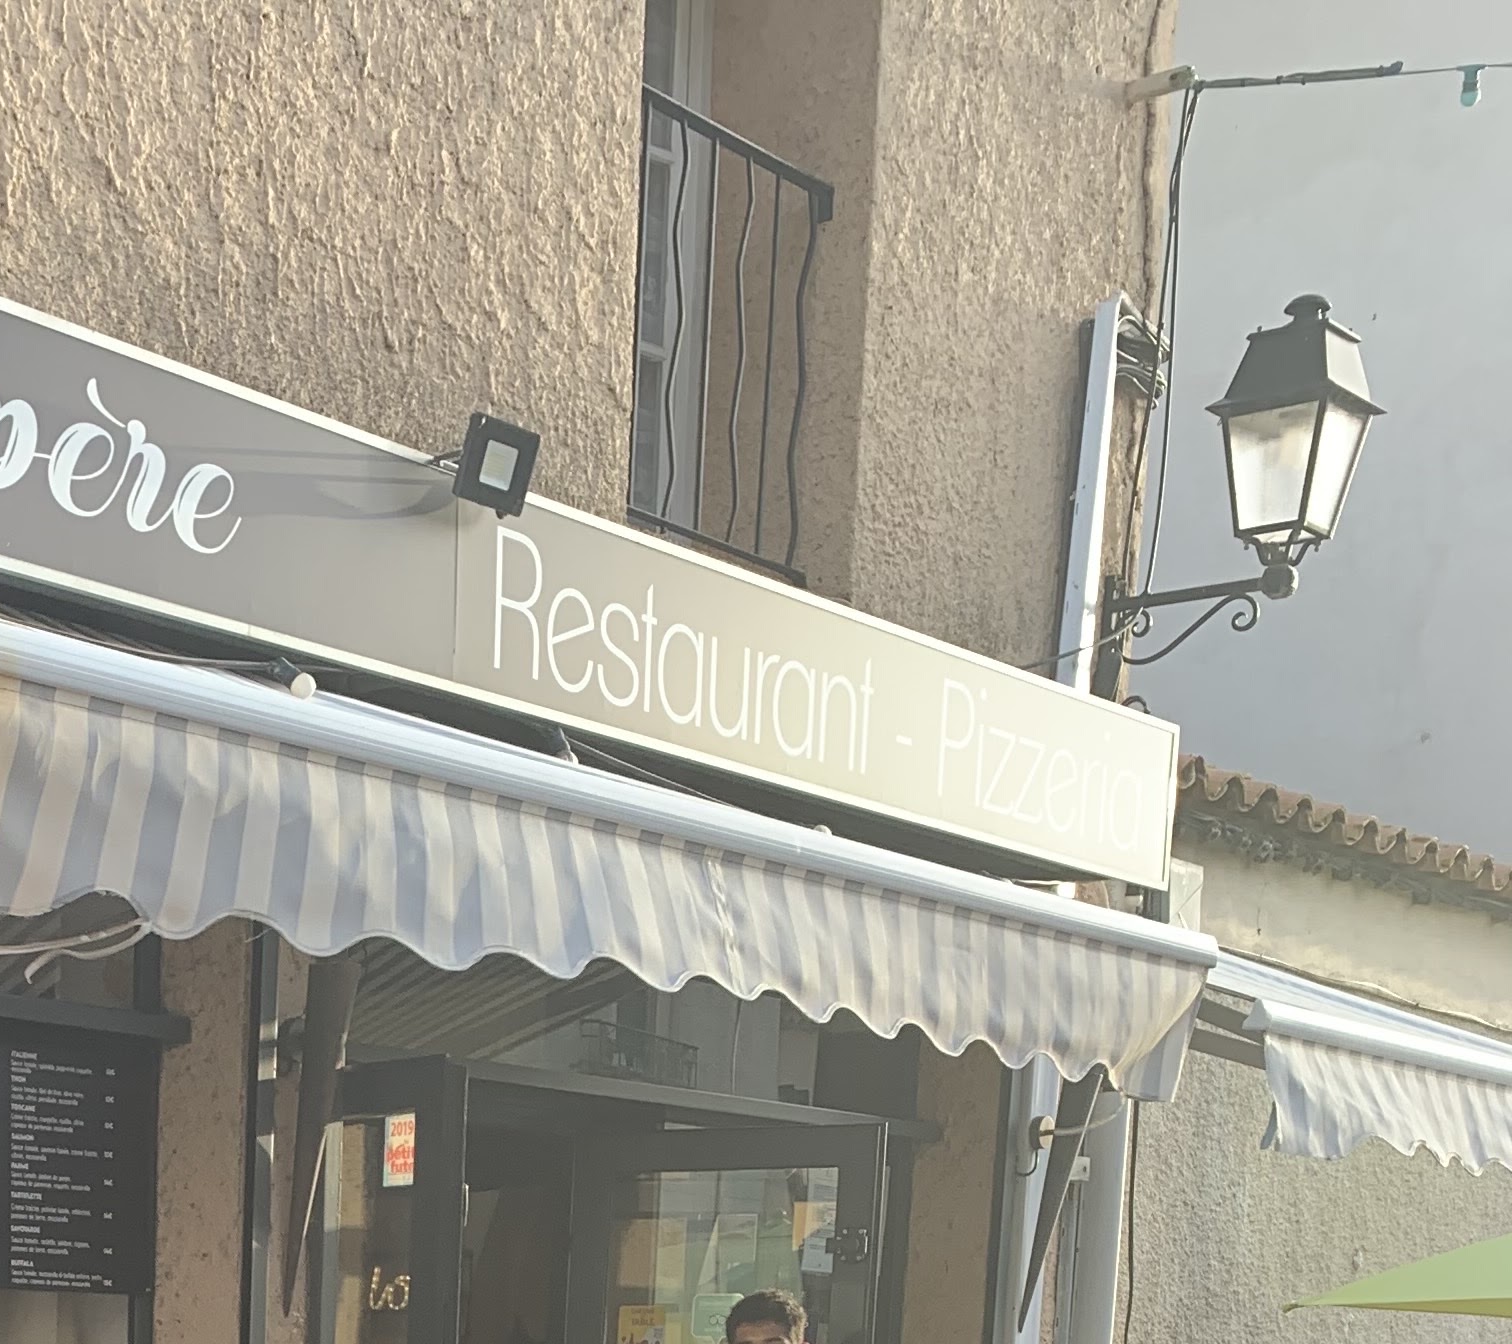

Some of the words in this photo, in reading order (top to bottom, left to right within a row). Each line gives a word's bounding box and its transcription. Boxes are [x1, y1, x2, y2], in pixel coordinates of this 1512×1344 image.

[494, 525, 876, 775] Restaurant
[896, 734, 914, 748] -
[937, 676, 1144, 854] Pizzeria
[390, 1120, 414, 1136] 2019
